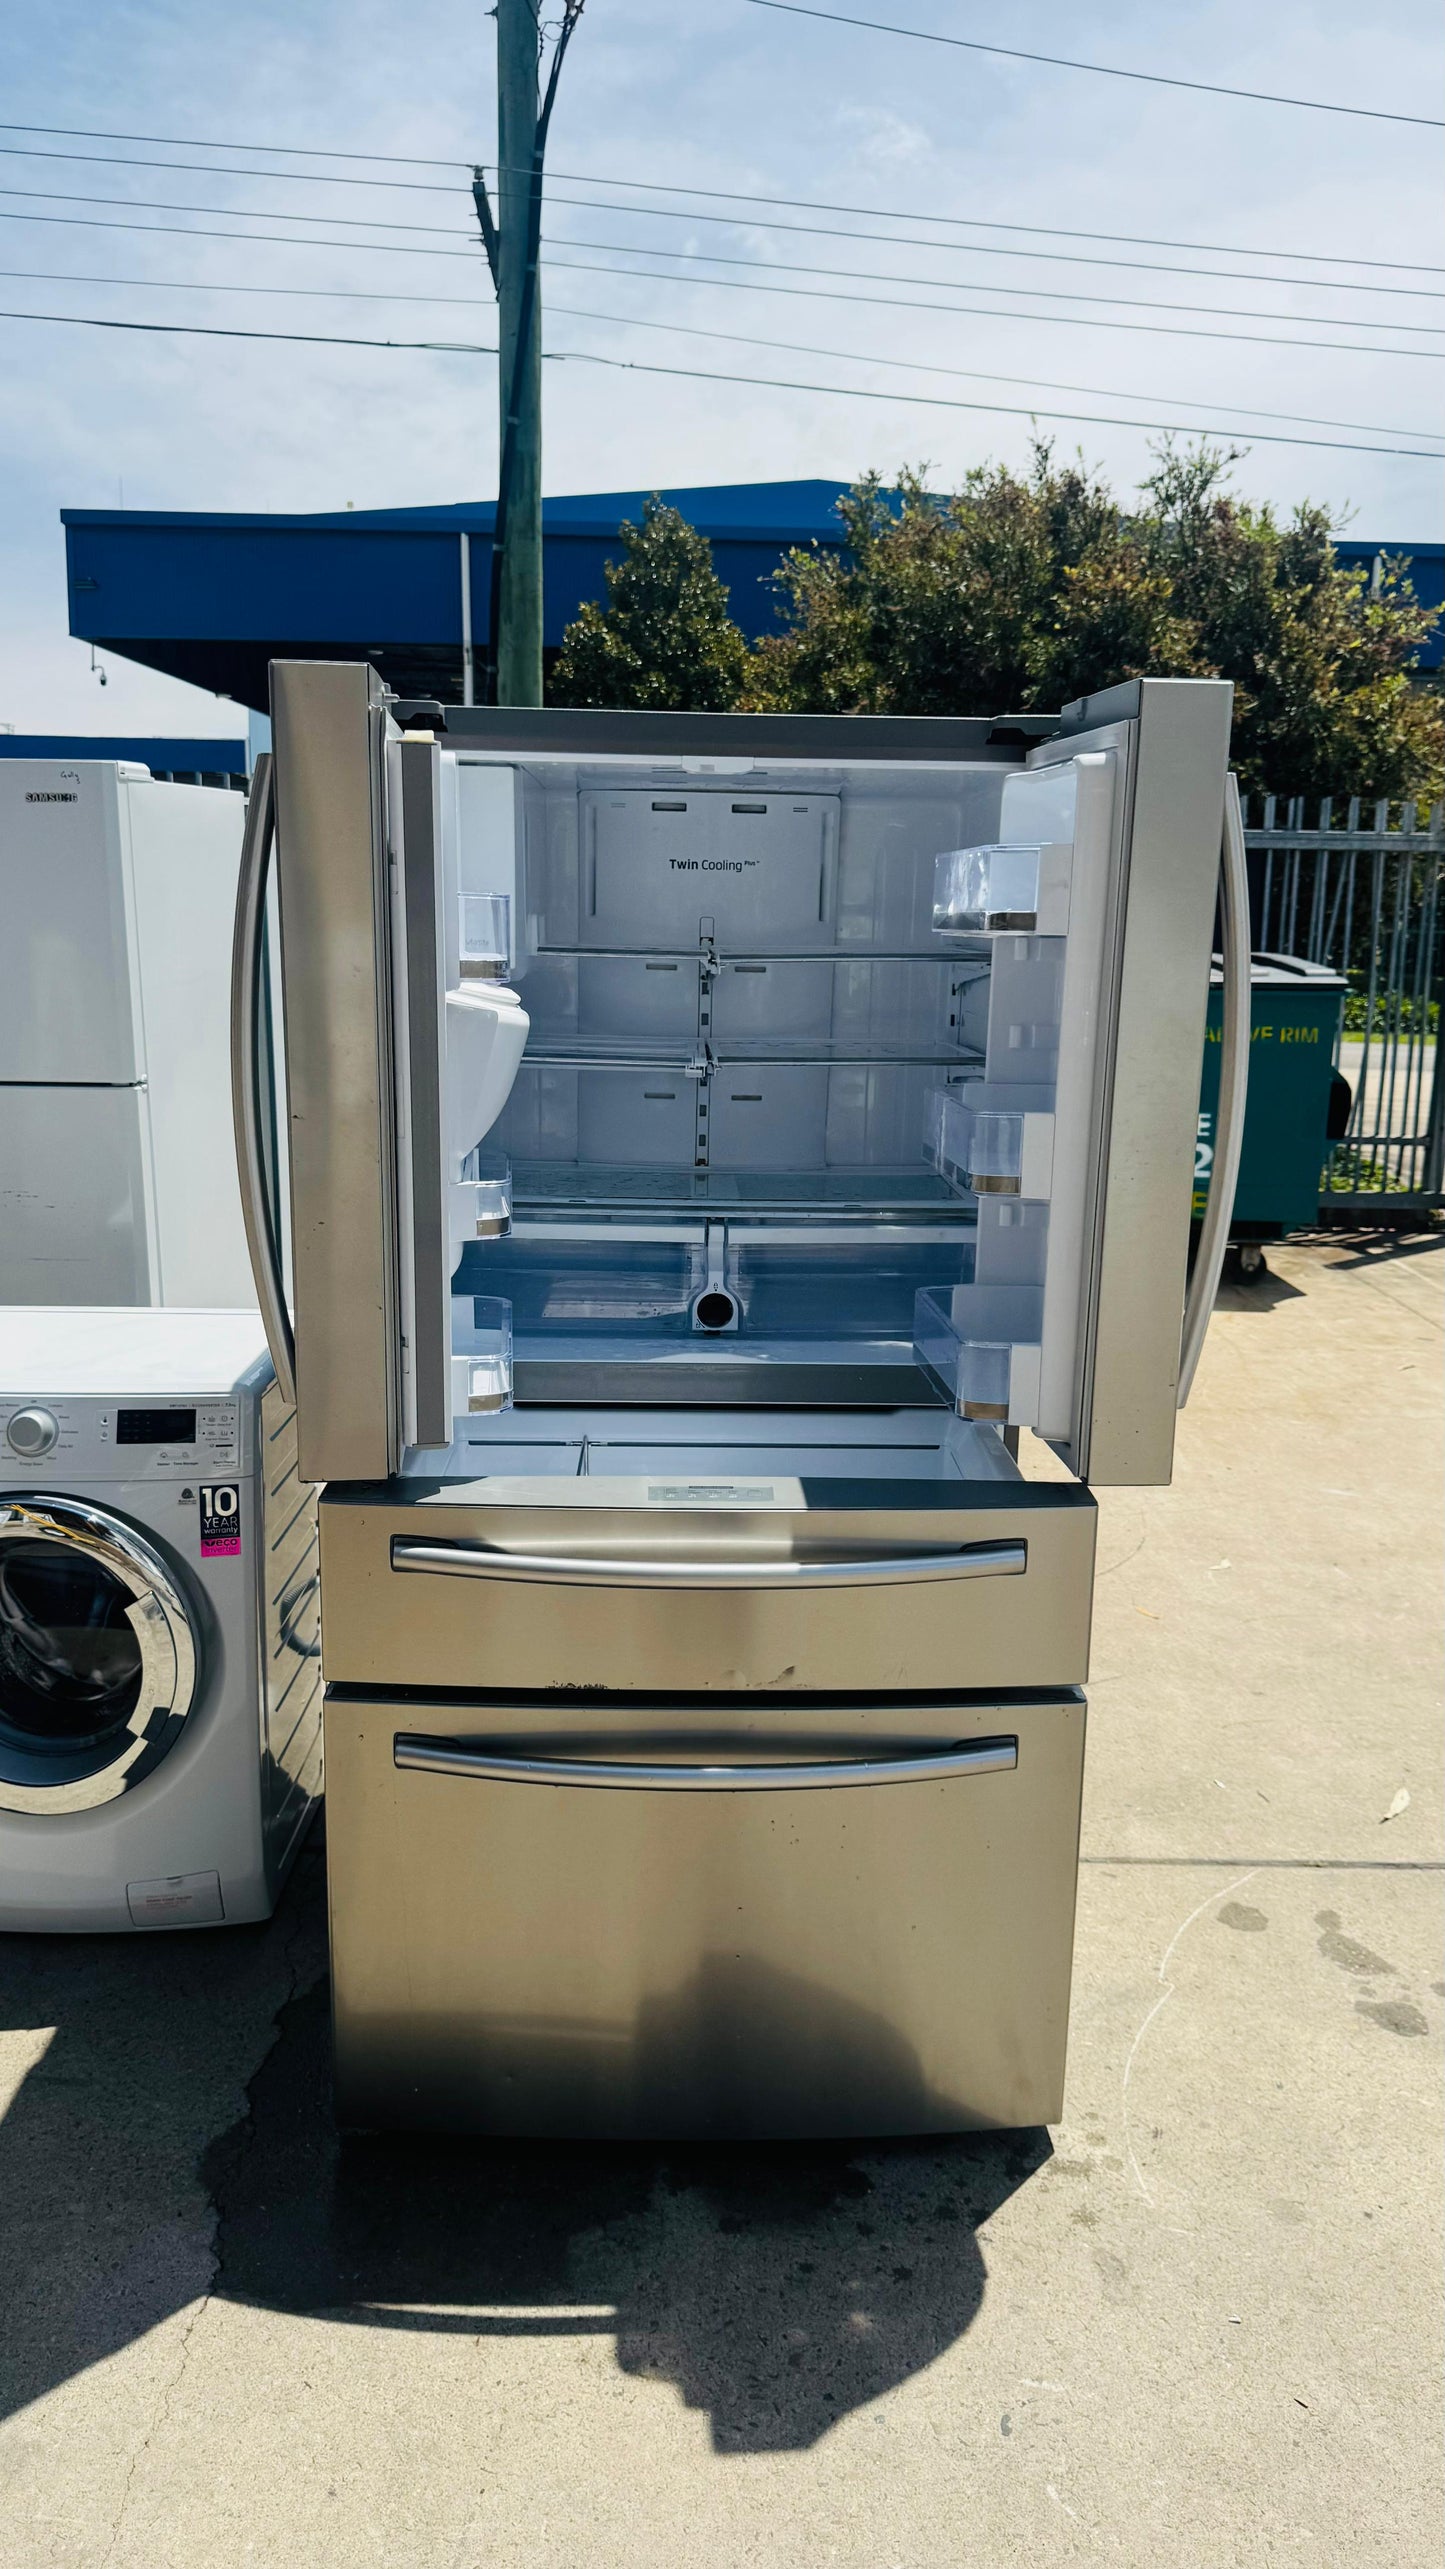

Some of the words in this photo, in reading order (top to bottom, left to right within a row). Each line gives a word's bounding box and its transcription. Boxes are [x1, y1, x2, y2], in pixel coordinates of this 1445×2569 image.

[669, 858, 698, 870] Twin
[701, 859, 742, 873] Cooling
[1280, 1027, 1319, 1044] RIM
[202, 1486, 238, 1517] 10
[203, 1516, 238, 1529] YEAR
[204, 1526, 238, 1535] warranty
